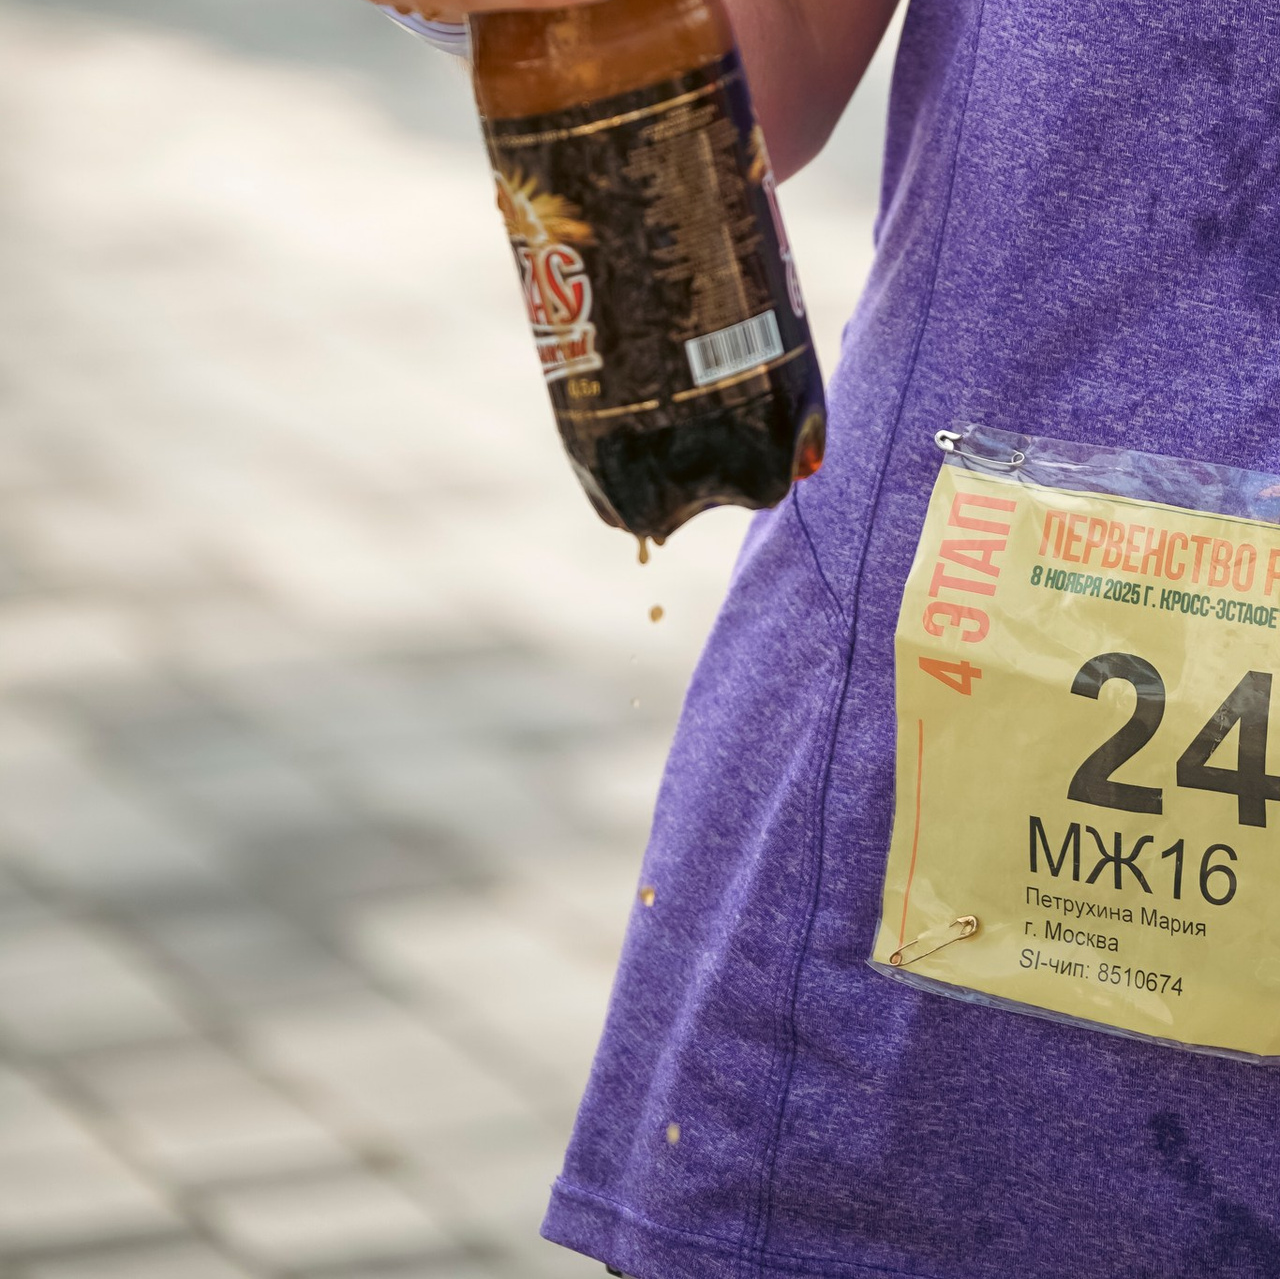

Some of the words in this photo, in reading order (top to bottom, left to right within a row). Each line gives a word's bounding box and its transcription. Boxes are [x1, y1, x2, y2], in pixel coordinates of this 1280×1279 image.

[922, 492, 1018, 643] ЭТАП
[1038, 509, 1257, 592] ПЕРВЕНСТВО
[1030, 565, 1044, 586] 8
[1044, 568, 1103, 598] НОЯБРЯ
[1103, 578, 1141, 605] 2025
[918, 656, 982, 697] 4
[1029, 815, 1238, 906] МЖ16
[1024, 920, 1037, 937] г.
[1044, 920, 1119, 952] Москва
[1026, 886, 1133, 923] Петрухина
[1140, 906, 1207, 937] Мария
[1019, 948, 1090, 979] SI-чип:
[1097, 962, 1183, 996] 8510674
